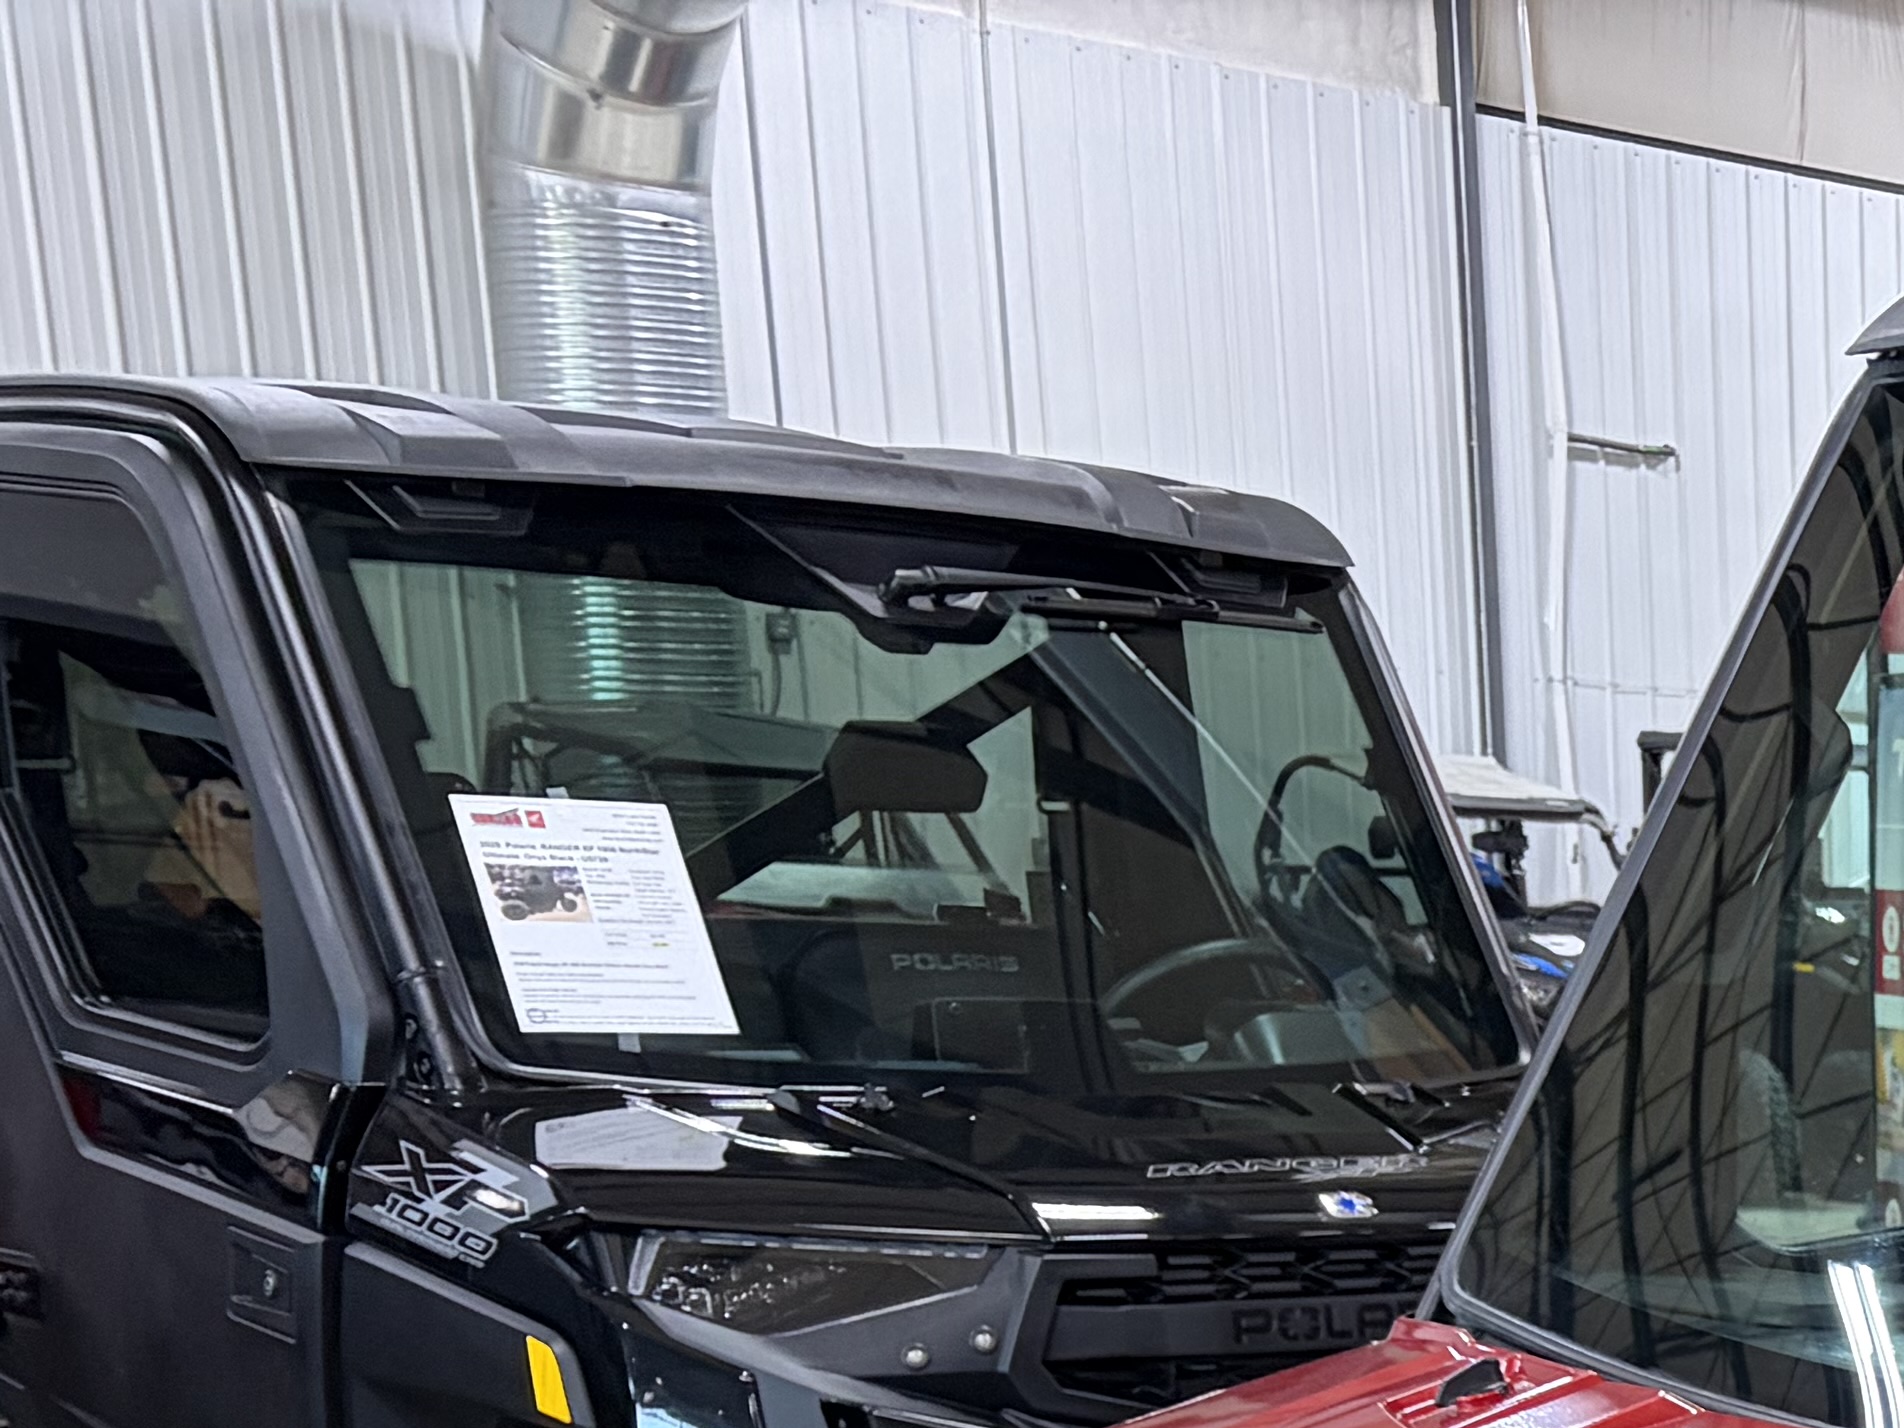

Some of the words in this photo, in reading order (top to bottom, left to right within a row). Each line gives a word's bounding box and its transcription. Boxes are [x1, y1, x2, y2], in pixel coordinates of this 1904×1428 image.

[890, 953, 1020, 973] POLARIS
[361, 1140, 530, 1223] XP
[1146, 1153, 1429, 1179] RANGER
[372, 1193, 498, 1261] 1000
[1232, 1302, 1416, 1345] POLA
